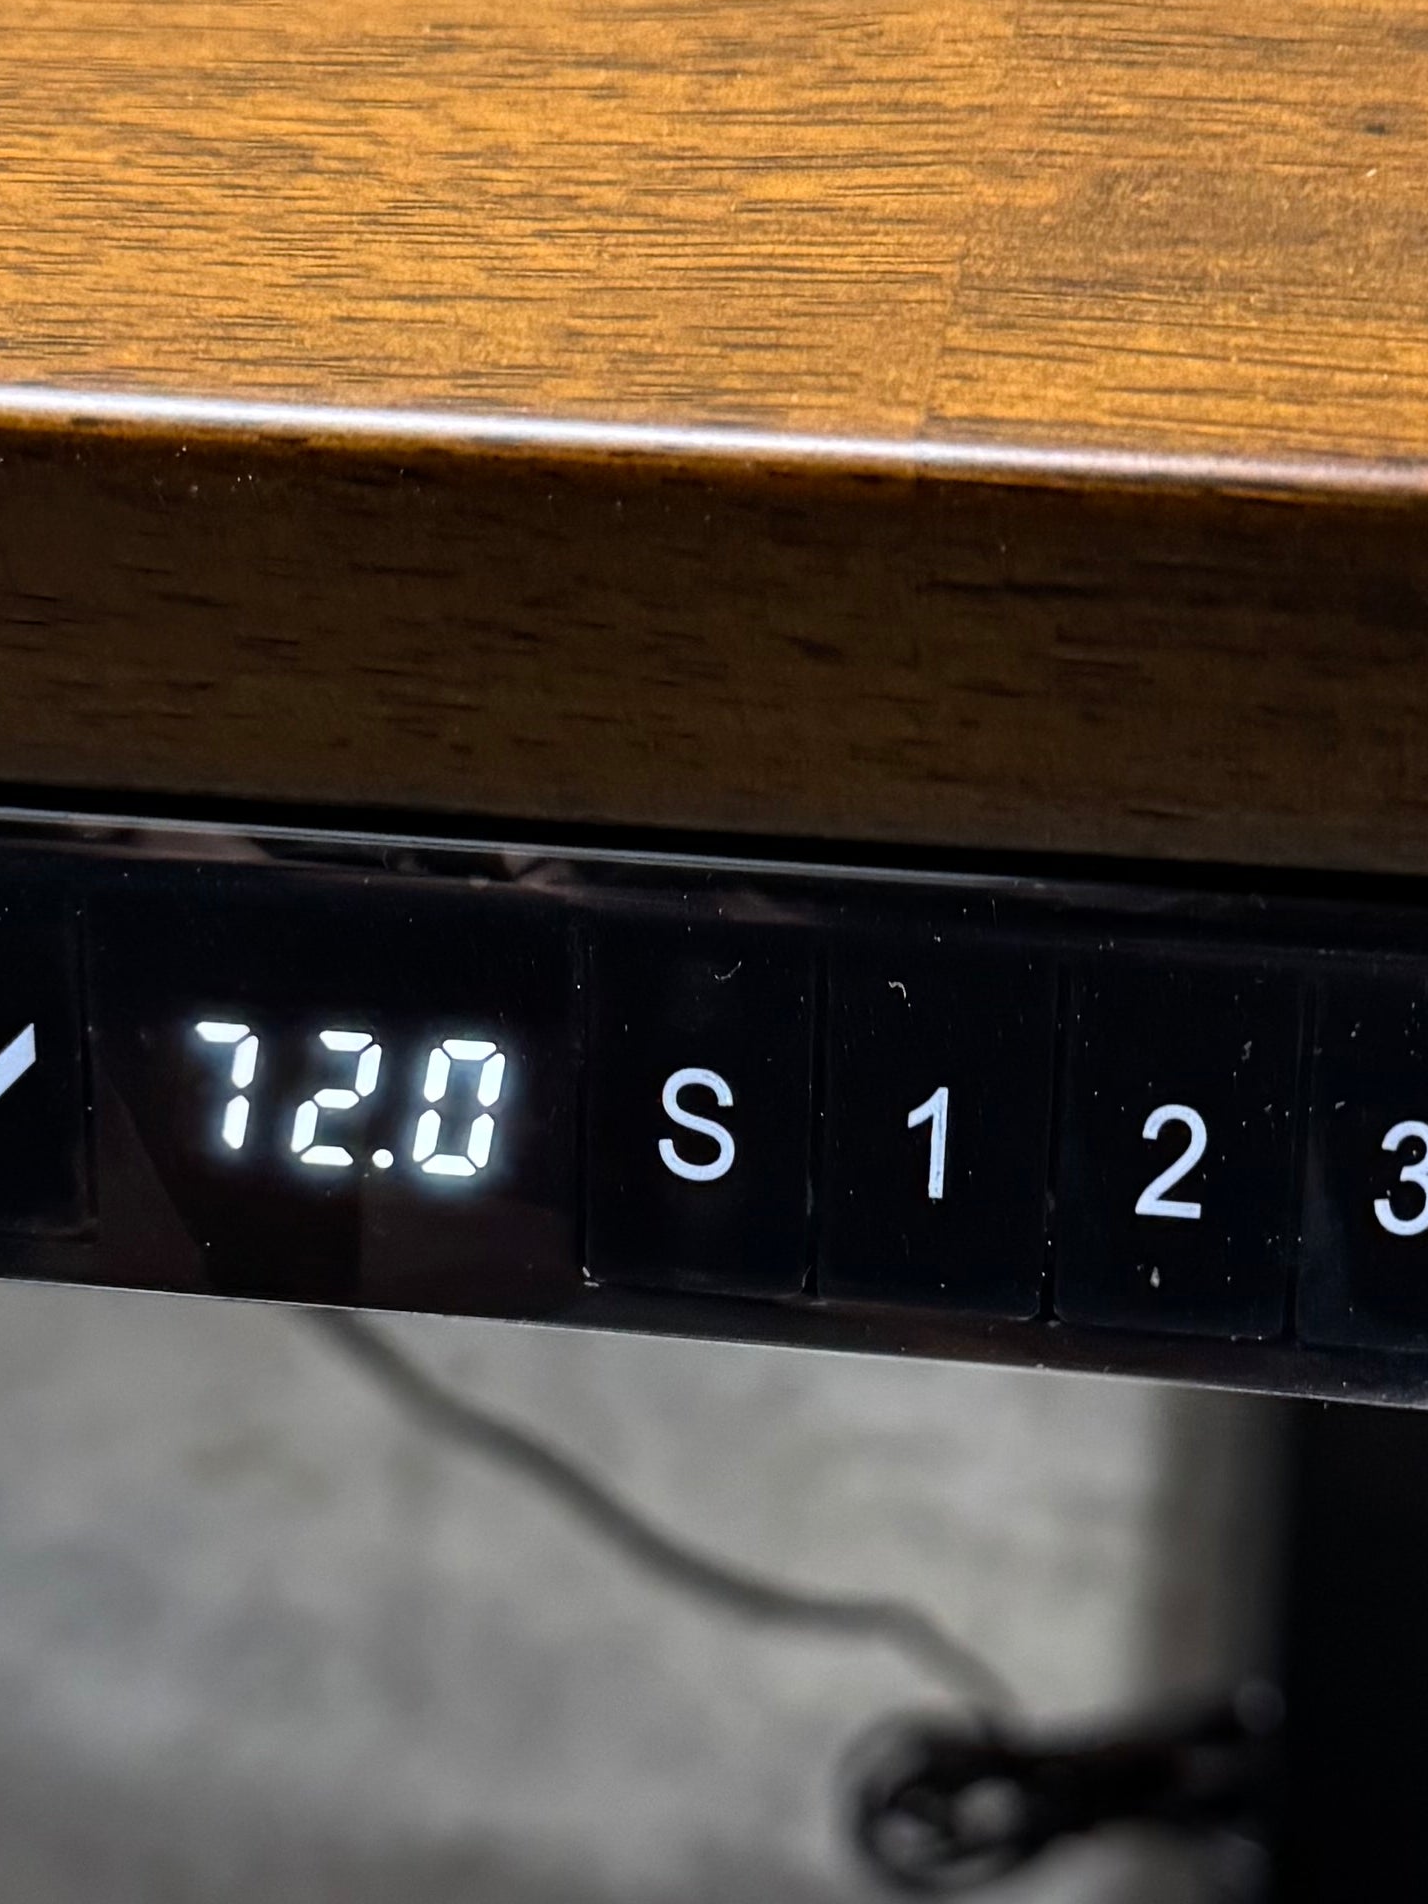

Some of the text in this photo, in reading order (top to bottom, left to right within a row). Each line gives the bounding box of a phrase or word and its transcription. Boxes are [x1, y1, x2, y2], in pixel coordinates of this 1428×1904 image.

[193, 1019, 506, 1180] 72.0
[658, 1067, 735, 1181] S
[907, 1086, 949, 1199] 1
[1134, 1104, 1208, 1219] 2
